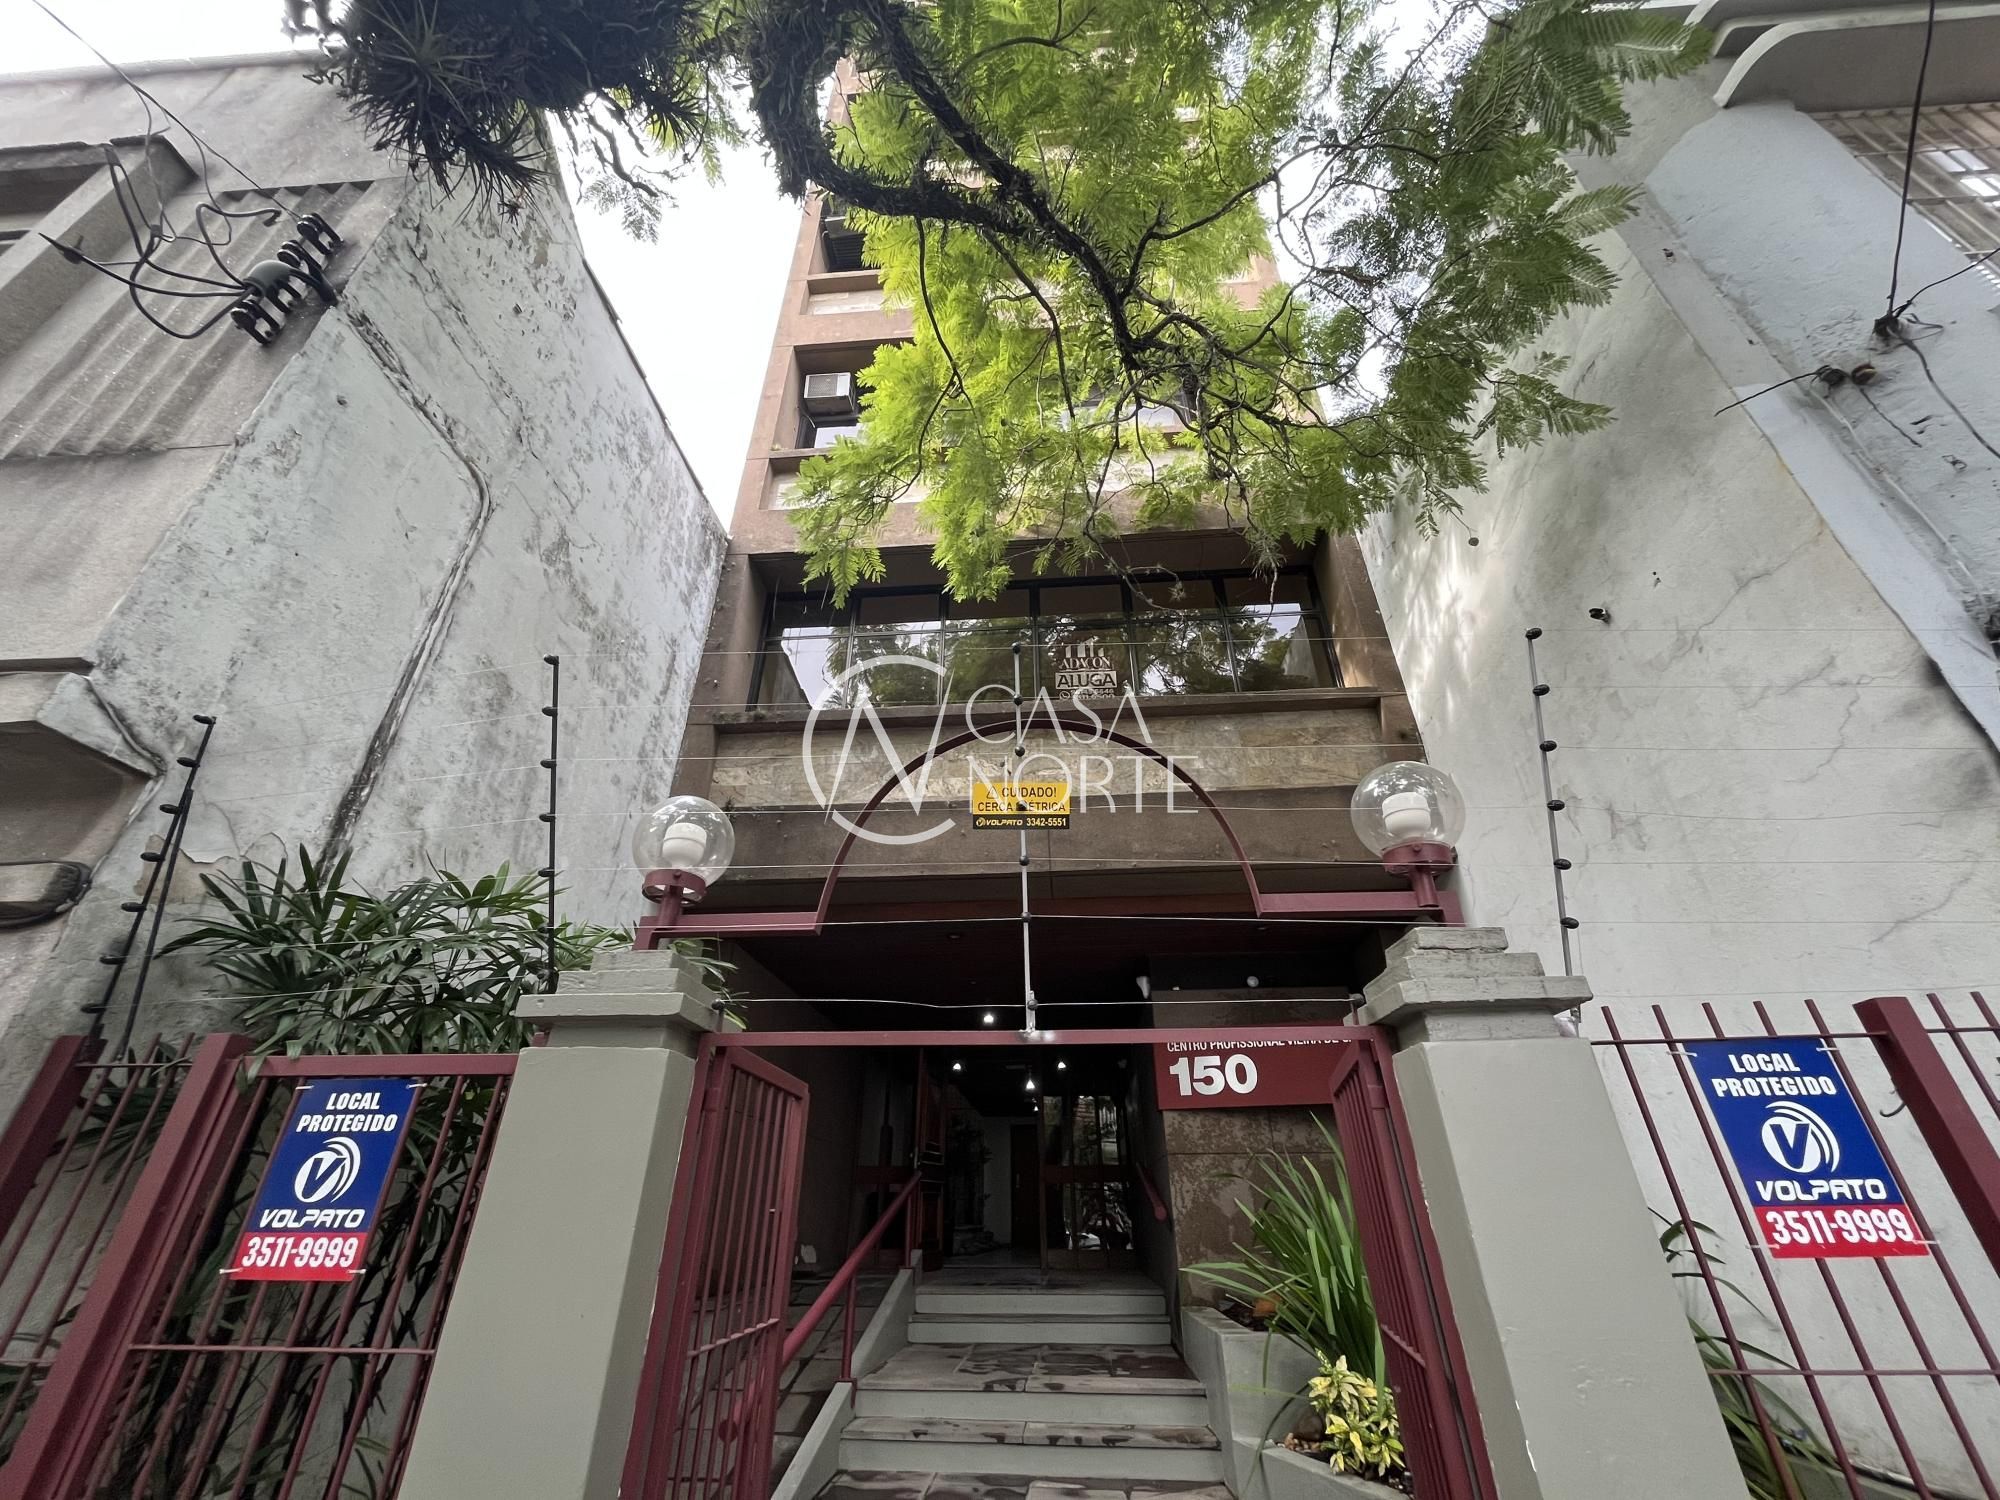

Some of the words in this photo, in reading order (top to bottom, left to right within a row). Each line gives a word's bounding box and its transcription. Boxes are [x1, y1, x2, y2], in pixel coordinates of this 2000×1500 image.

[1057, 673, 1116, 688] ALUGA
[977, 802, 1012, 812] CERCA
[1026, 817, 1066, 827] 3342-5551
[1167, 1041, 1207, 1052] CENTRO
[1728, 1053, 1801, 1073] LOCAL
[1169, 1054, 1258, 1096] 150
[1711, 1076, 1837, 1097] PROTEGIDO
[325, 1092, 381, 1110] LOCAL
[295, 1114, 398, 1133] PROTEGIDO
[1756, 1178, 1887, 1202] VOLPATO
[259, 1208, 366, 1228] VOLPATO
[1765, 1208, 1914, 1245] 3511-9999
[241, 1236, 359, 1268] 3511-9999
